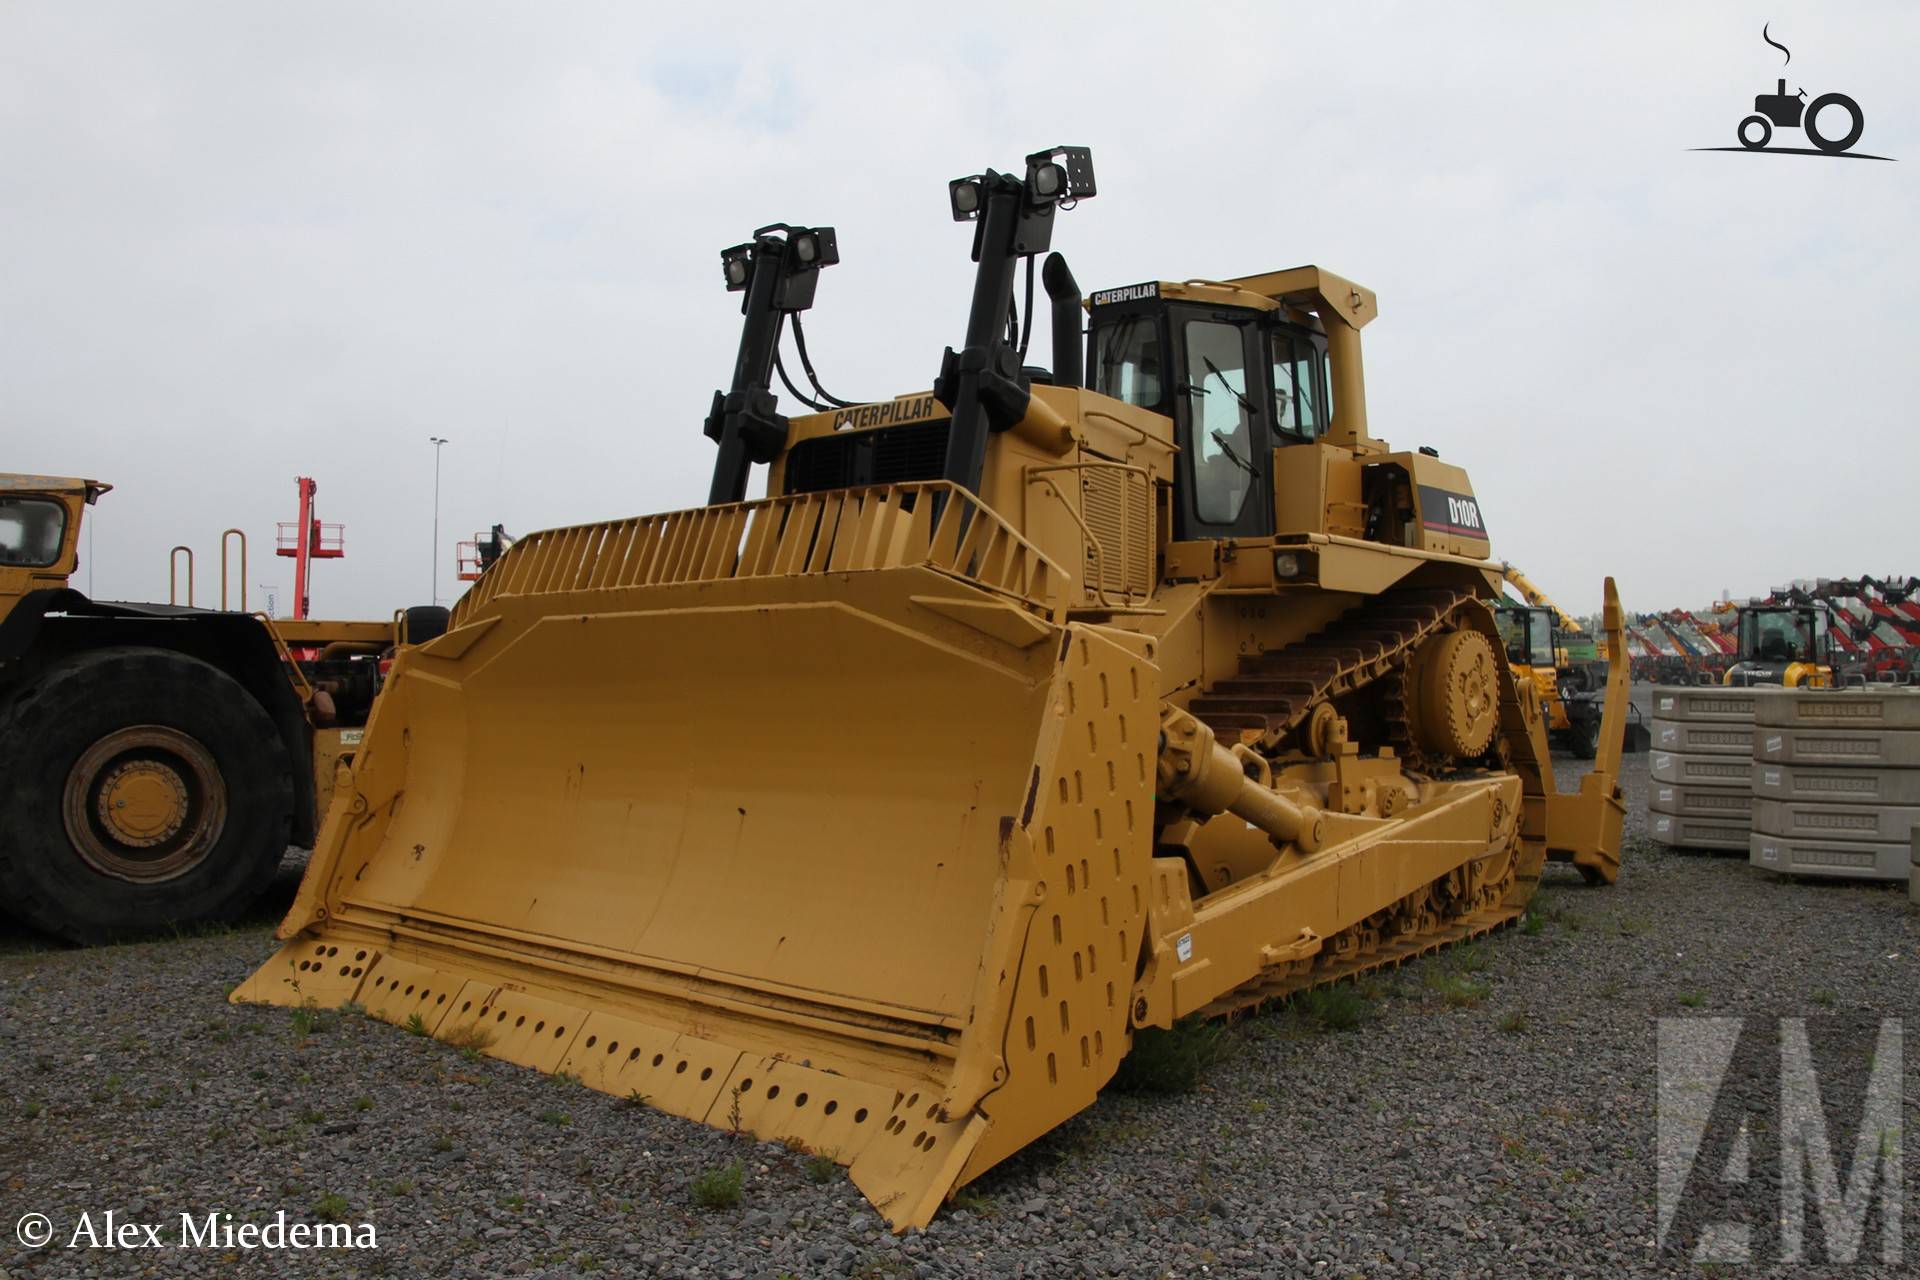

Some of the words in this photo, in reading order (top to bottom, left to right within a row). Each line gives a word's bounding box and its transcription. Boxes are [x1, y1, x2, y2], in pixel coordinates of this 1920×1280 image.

[1095, 284, 1156, 305] CATERPILLAR
[833, 397, 934, 431] CATERPILLAR
[1448, 497, 1480, 529] D10R
